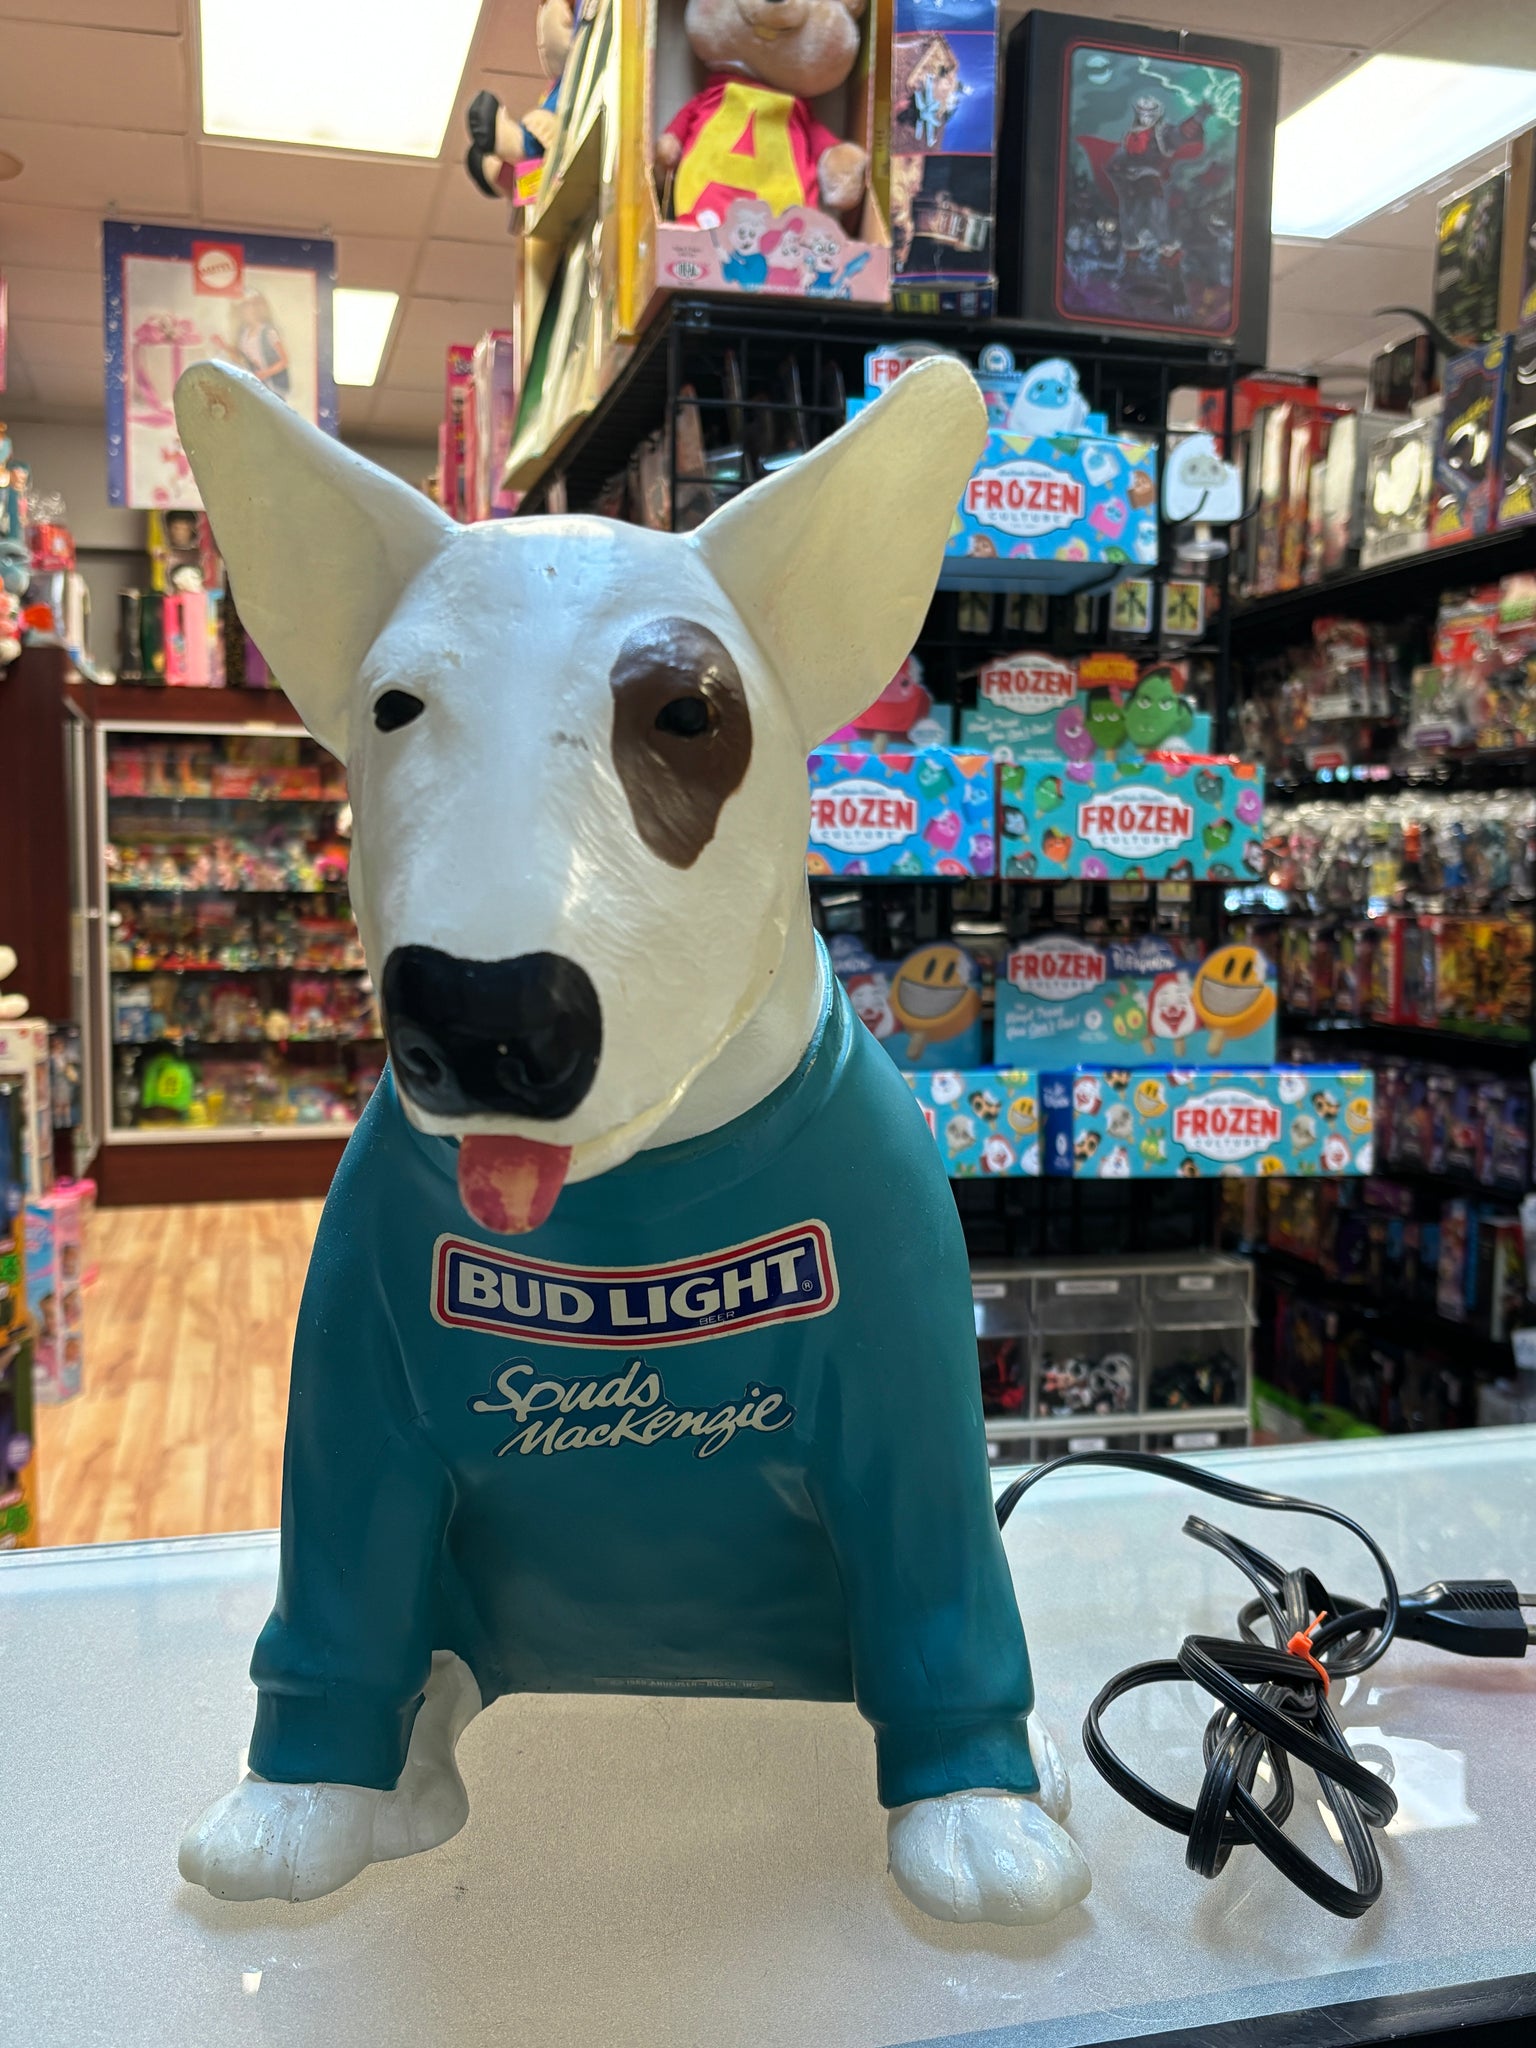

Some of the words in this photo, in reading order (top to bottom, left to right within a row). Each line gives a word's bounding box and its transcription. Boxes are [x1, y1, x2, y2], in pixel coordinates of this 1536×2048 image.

[968, 479, 1080, 517] FROZEN
[984, 669, 1075, 698] FROZEN
[1081, 803, 1190, 838] FROZEN
[1010, 953, 1105, 980] FROZEN
[1175, 1107, 1281, 1141] FROZEN
[458, 1260, 595, 1324] BUD
[610, 1246, 806, 1327] LIGHT
[699, 1310, 736, 1326] BEER
[472, 1360, 660, 1423] Spuds
